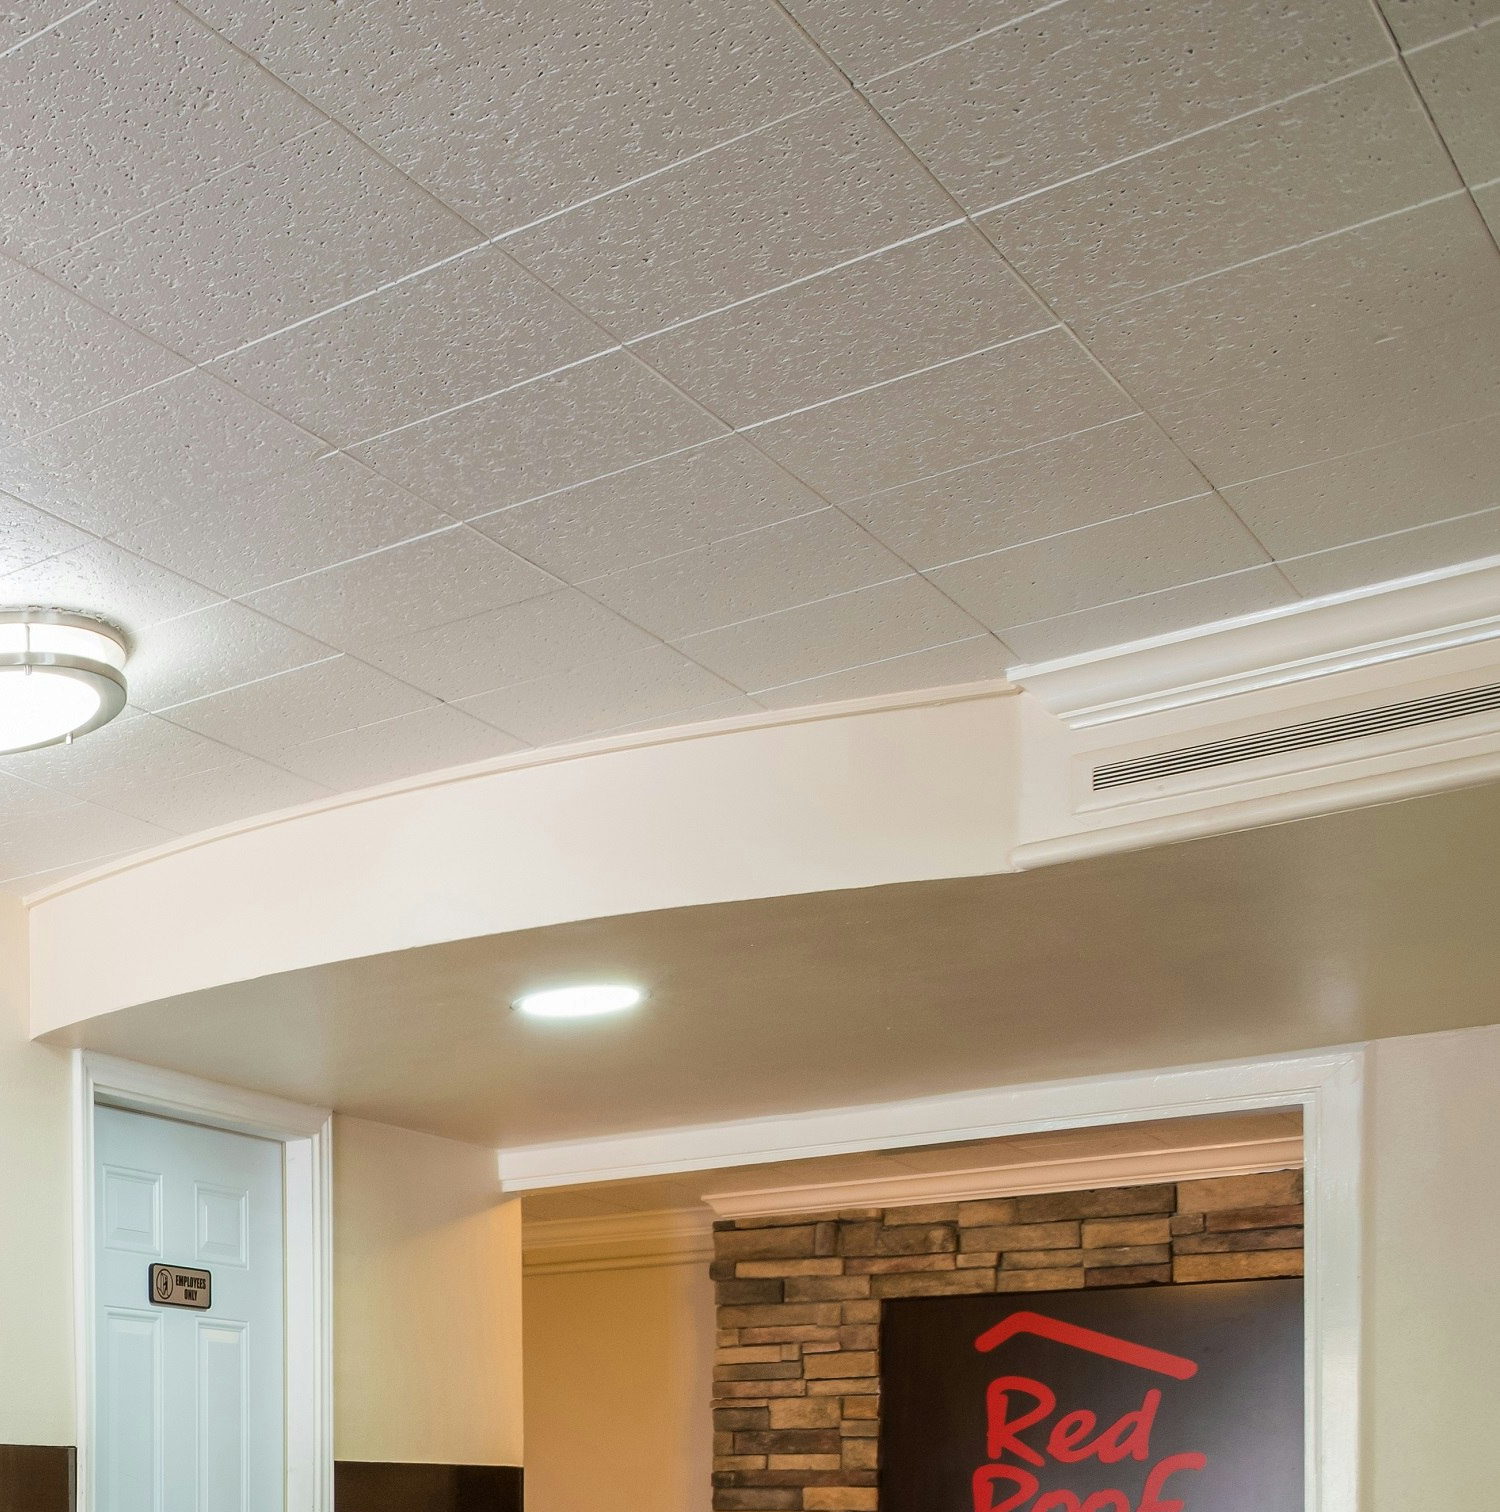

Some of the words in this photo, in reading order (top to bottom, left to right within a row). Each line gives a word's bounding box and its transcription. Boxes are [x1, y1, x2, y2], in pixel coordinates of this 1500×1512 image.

[175, 1274, 207, 1290] EMPLOYEES
[184, 1288, 198, 1301] ONLY
[985, 1375, 1162, 1468] Red
